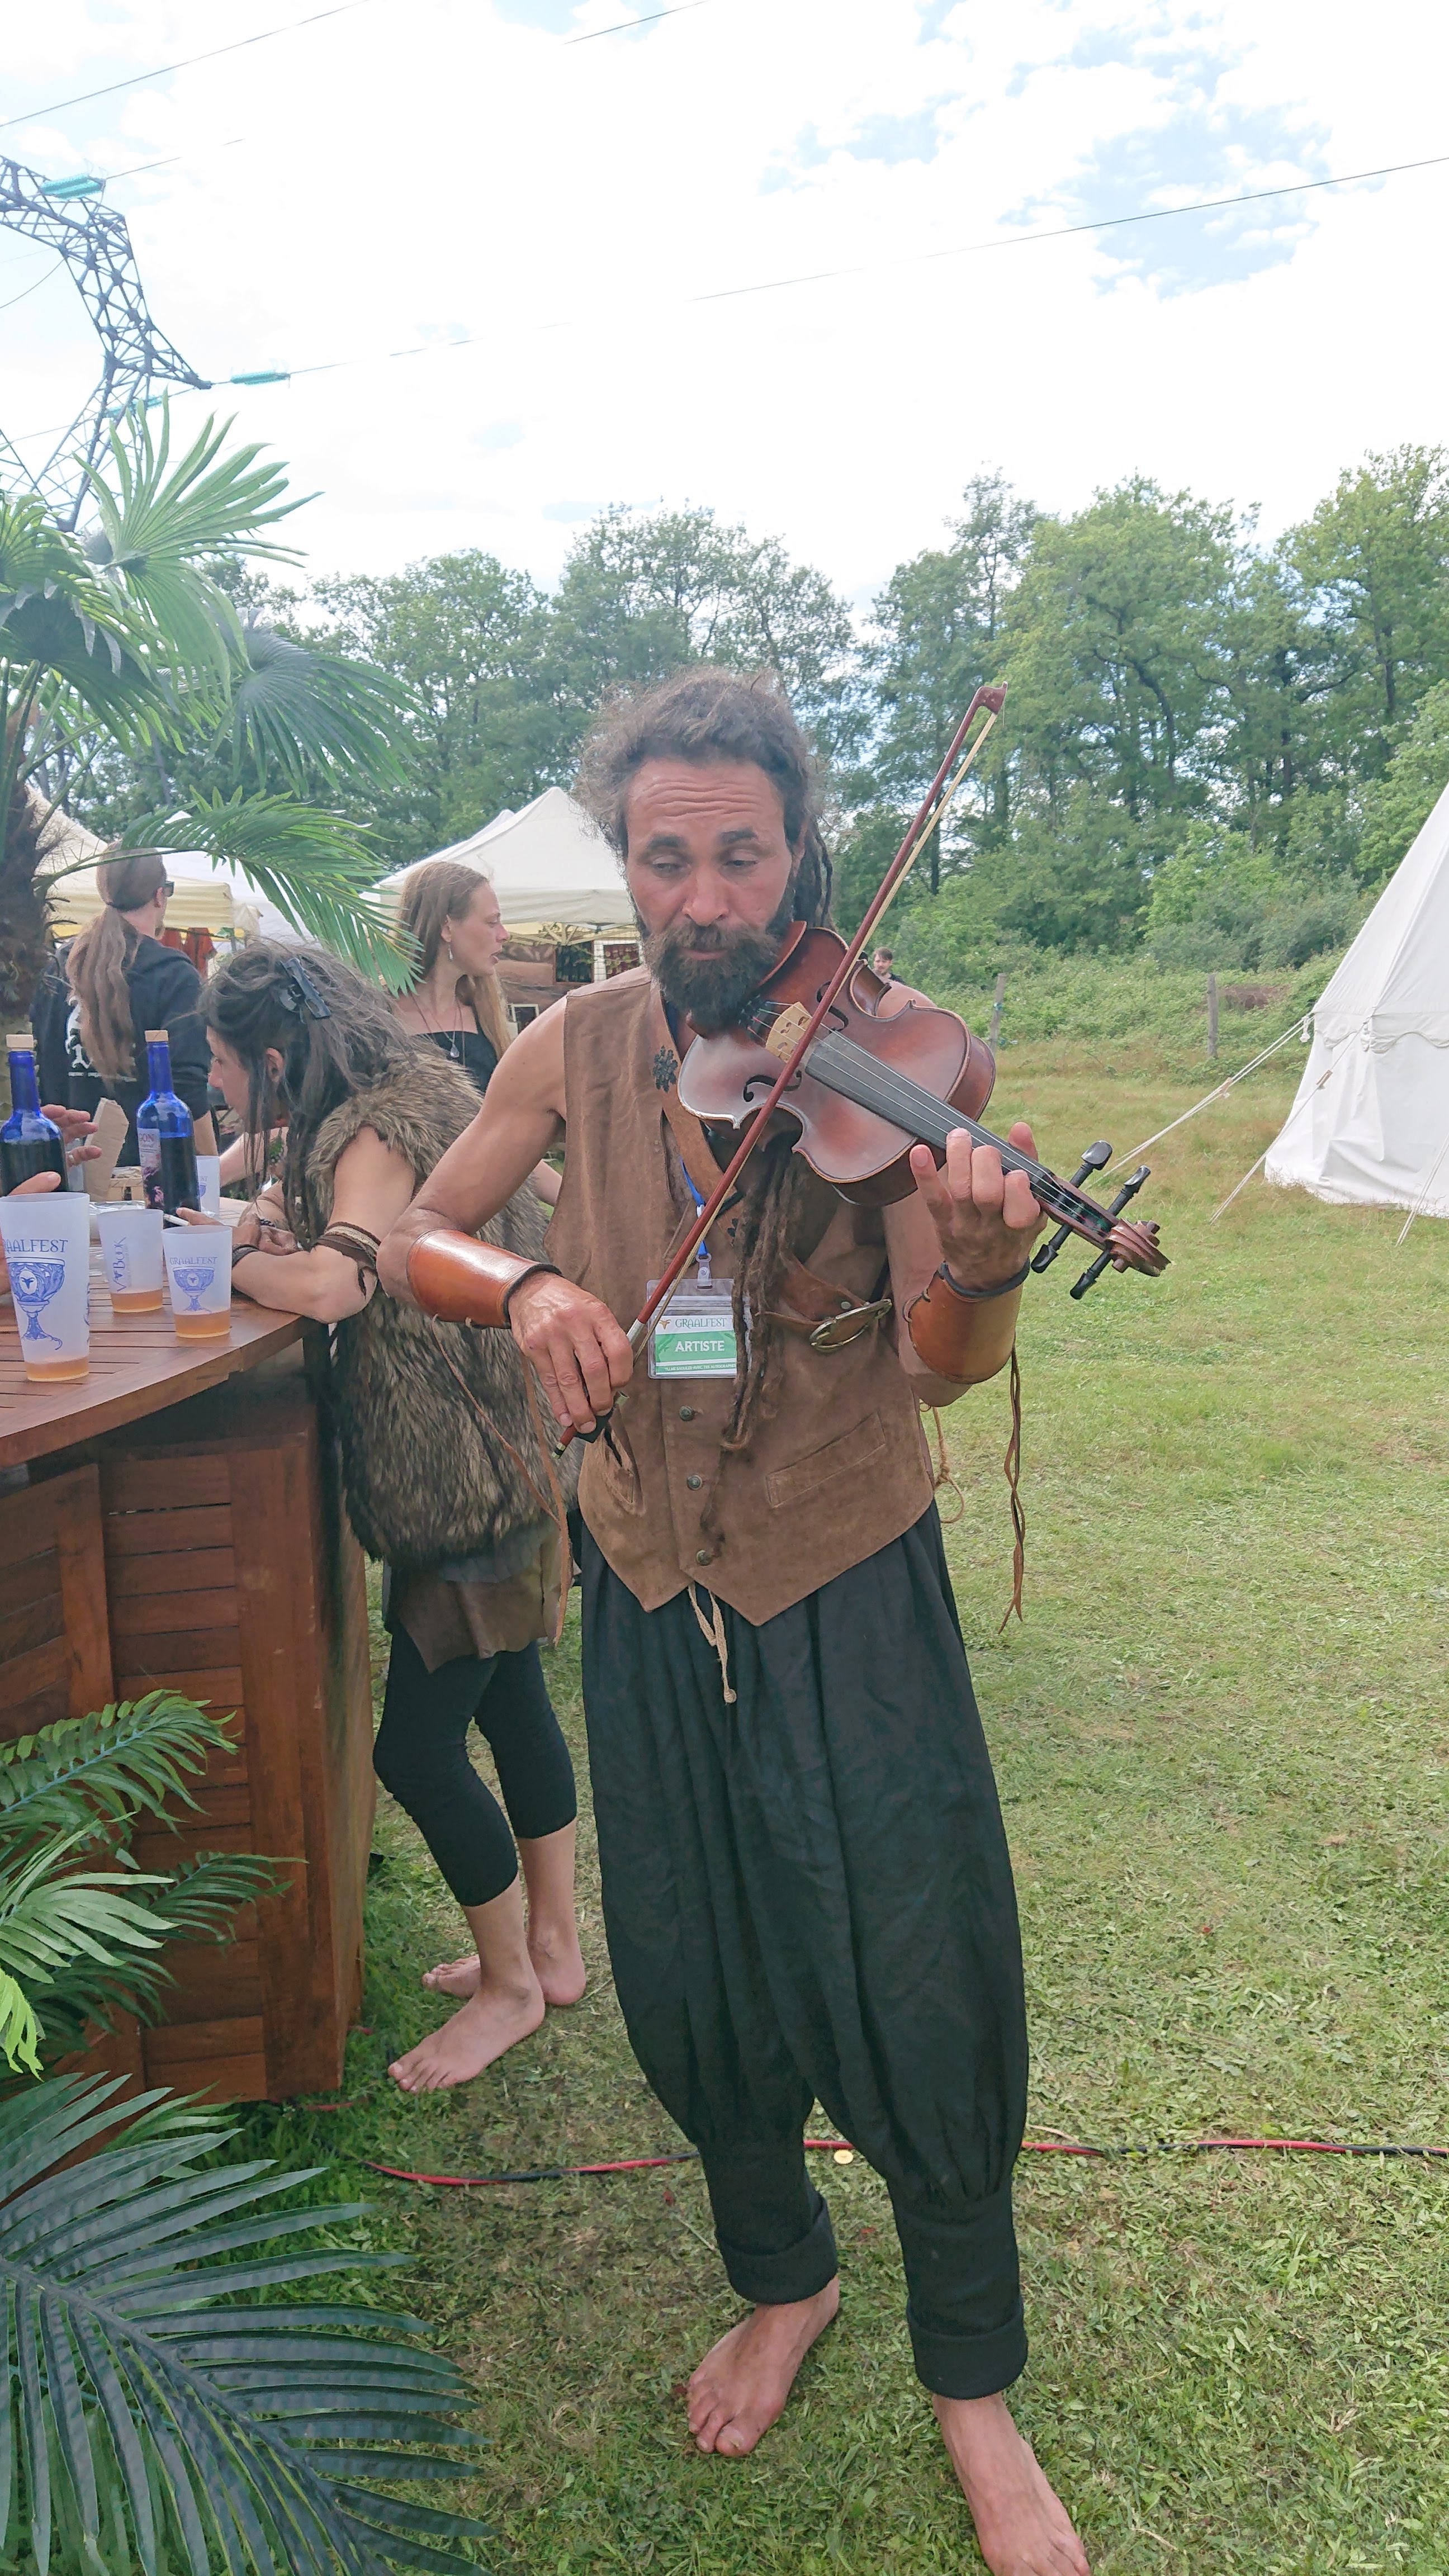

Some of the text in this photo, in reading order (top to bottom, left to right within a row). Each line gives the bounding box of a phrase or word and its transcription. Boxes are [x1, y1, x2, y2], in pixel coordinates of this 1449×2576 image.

[169, 1257, 218, 1265] GRAALFEST
[675, 1318, 727, 1329] GRAALFEST
[674, 1341, 725, 1352] ARTISTE
